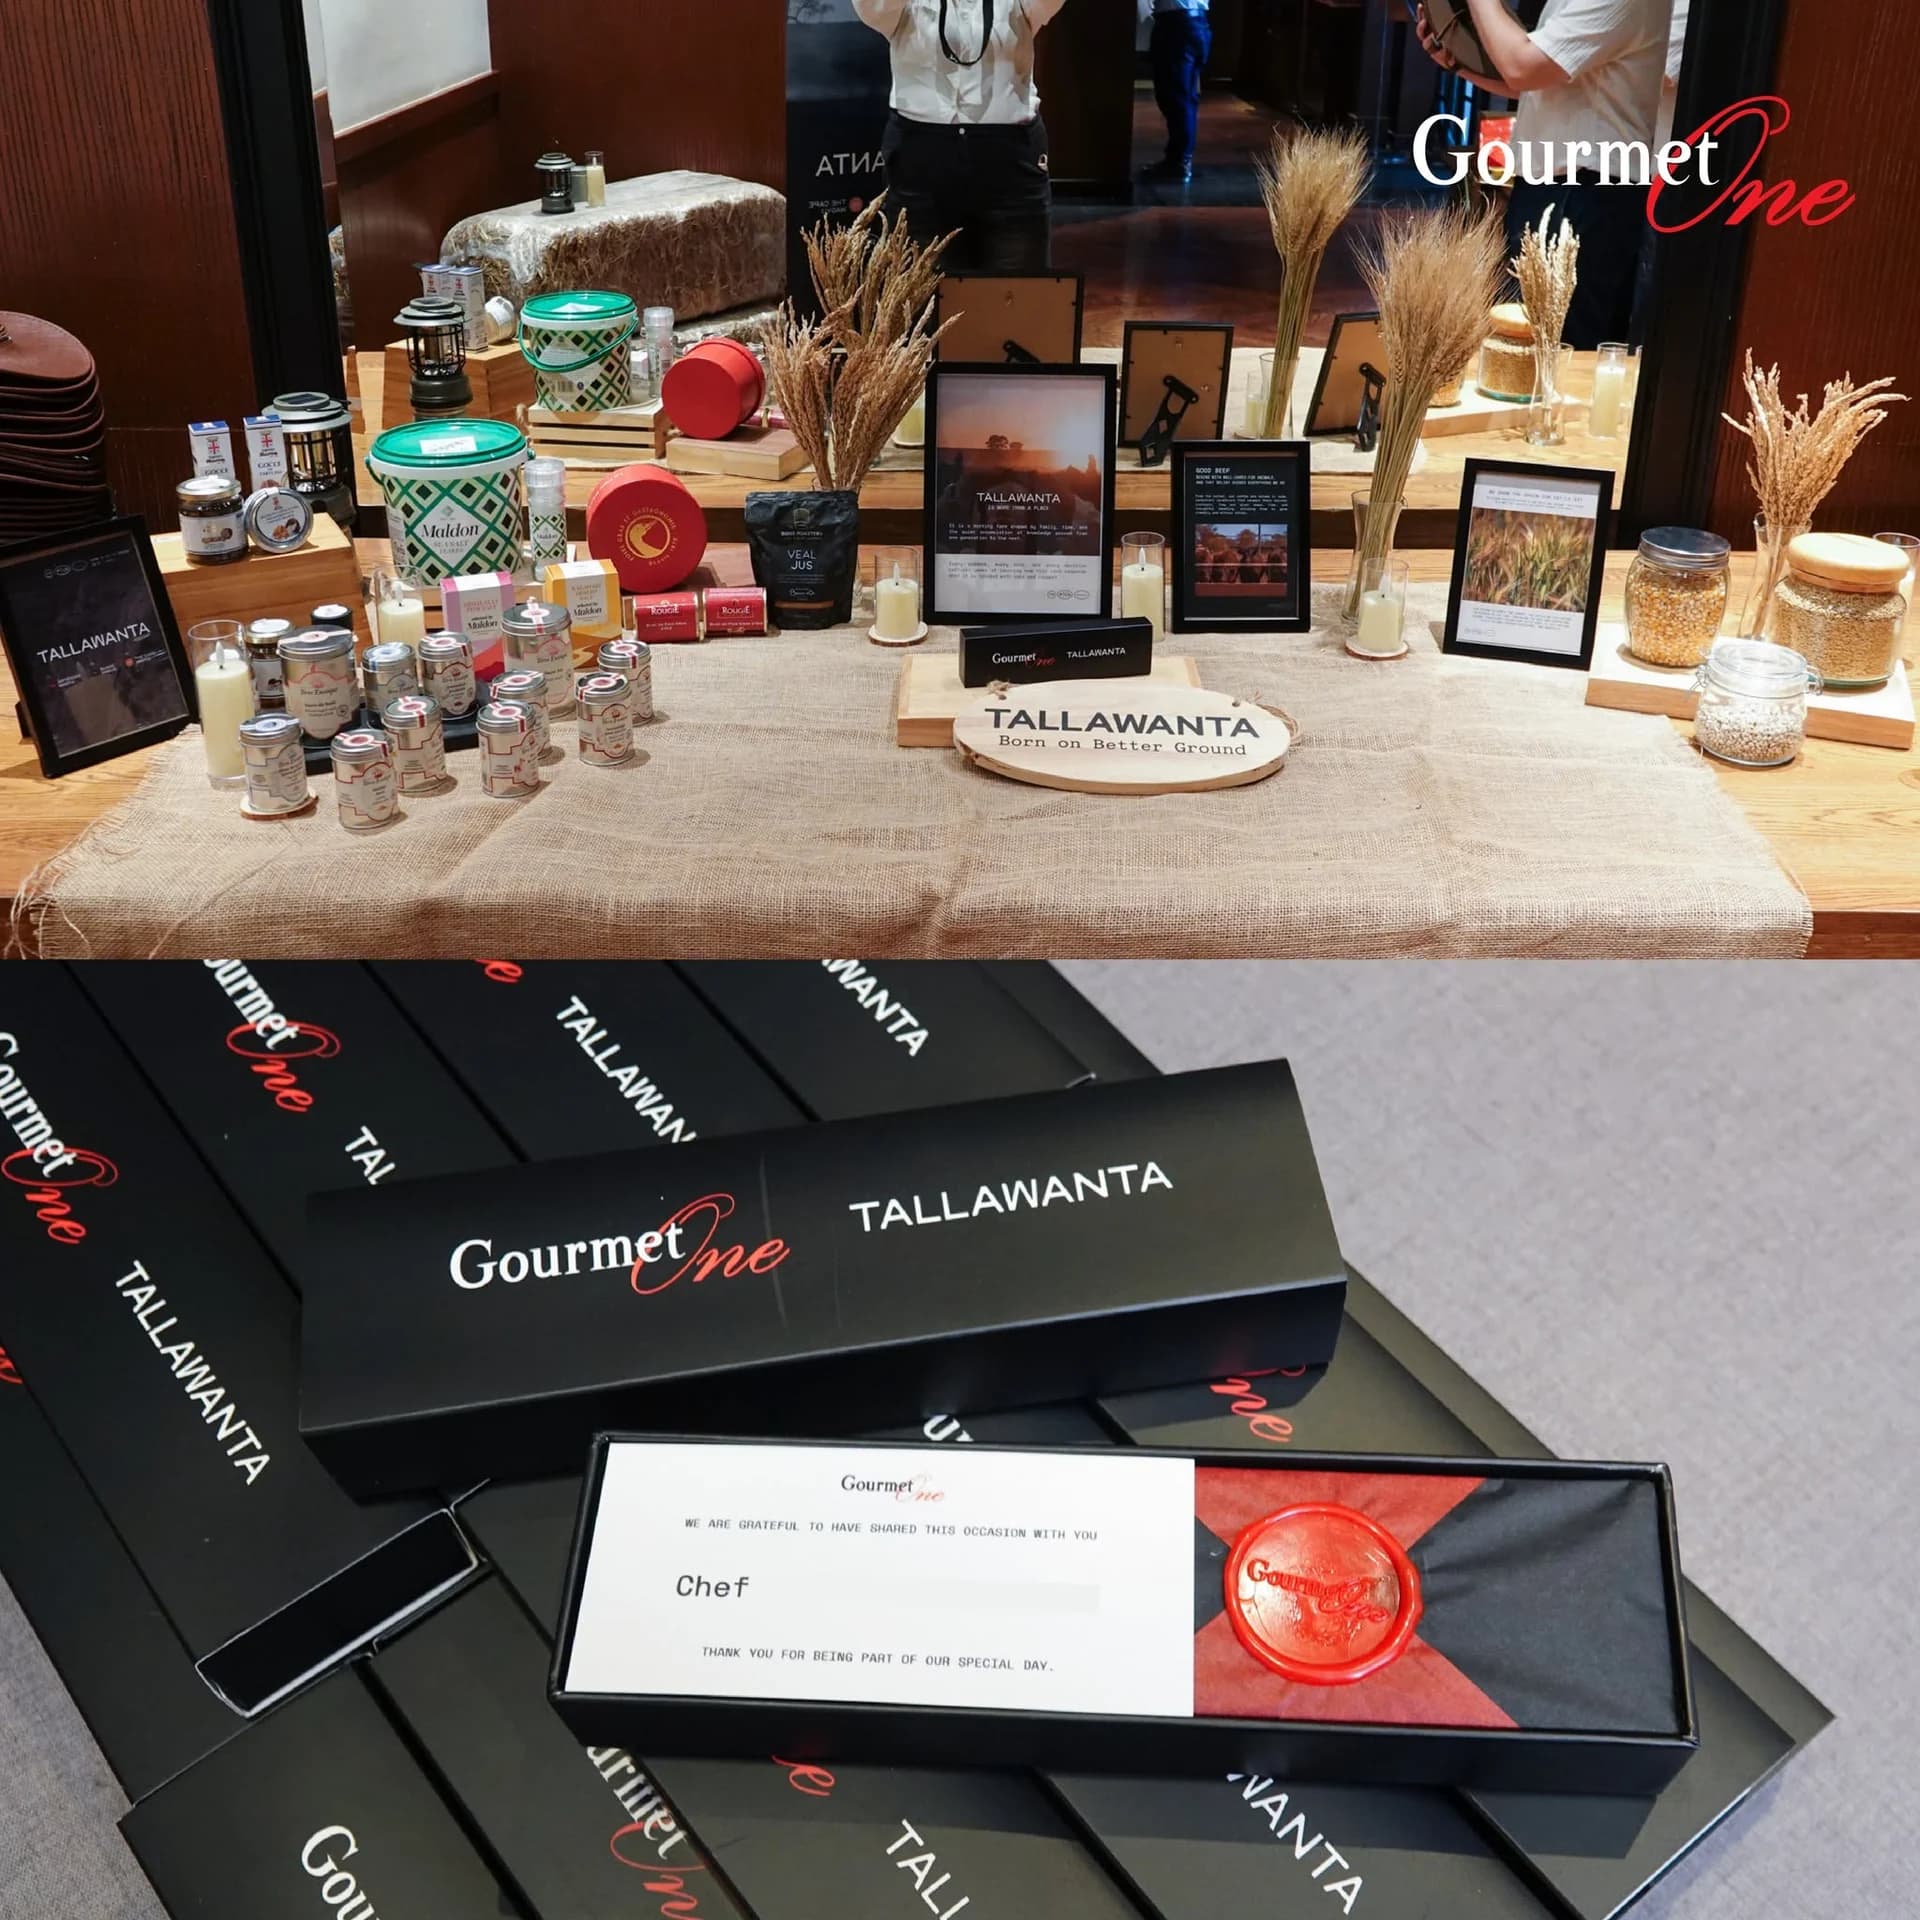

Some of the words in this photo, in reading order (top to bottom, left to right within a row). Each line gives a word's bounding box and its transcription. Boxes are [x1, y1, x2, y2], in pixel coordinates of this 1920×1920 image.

[976, 492, 1061, 503] TALLAWANTA
[421, 523, 480, 538] Maldon
[787, 549, 817, 560] VEAL
[791, 561, 813, 570] JUS
[573, 607, 602, 617] Maldon
[468, 620, 498, 630] Maldon
[36, 622, 151, 664] TALLAWANTA
[1066, 647, 1126, 660] TALLAWANTA
[992, 652, 1036, 664] Gourmet
[985, 707, 1260, 738] TALLAWANTA
[999, 735, 1046, 748] Born
[1057, 739, 1081, 749] on
[1093, 739, 1162, 753] Better
[1174, 742, 1247, 756] Ground
[226, 1020, 342, 1112] One
[1, 1146, 119, 1244] One
[849, 1161, 1174, 1233] TALLAWANTA
[449, 1222, 686, 1290] Gourmet
[630, 1193, 791, 1295] One
[115, 1259, 270, 1486] TALLAWANTA
[841, 1474, 913, 1493] Gourmet
[685, 1518, 701, 1529] WE
[708, 1519, 731, 1529] ARE
[739, 1520, 800, 1531] GRATEFUL
[809, 1522, 824, 1532] TO
[831, 1522, 862, 1533] HAVE
[869, 1523, 917, 1534] SHARED
[926, 1524, 956, 1535] THIS
[963, 1526, 1027, 1538] OCCASION
[1033, 1529, 1066, 1540] WITH
[1074, 1530, 1098, 1540] YOU
[676, 1574, 750, 1598] Chef
[702, 1646, 741, 1658] THANK
[749, 1648, 774, 1659] YOU
[781, 1649, 806, 1660] FOR
[813, 1651, 854, 1663] BEING
[861, 1653, 893, 1664] PART
[901, 1654, 917, 1665] OF
[925, 1655, 950, 1667] OUR
[958, 1656, 1014, 1670] SPECIAL
[1023, 1659, 1056, 1672] DAY.
